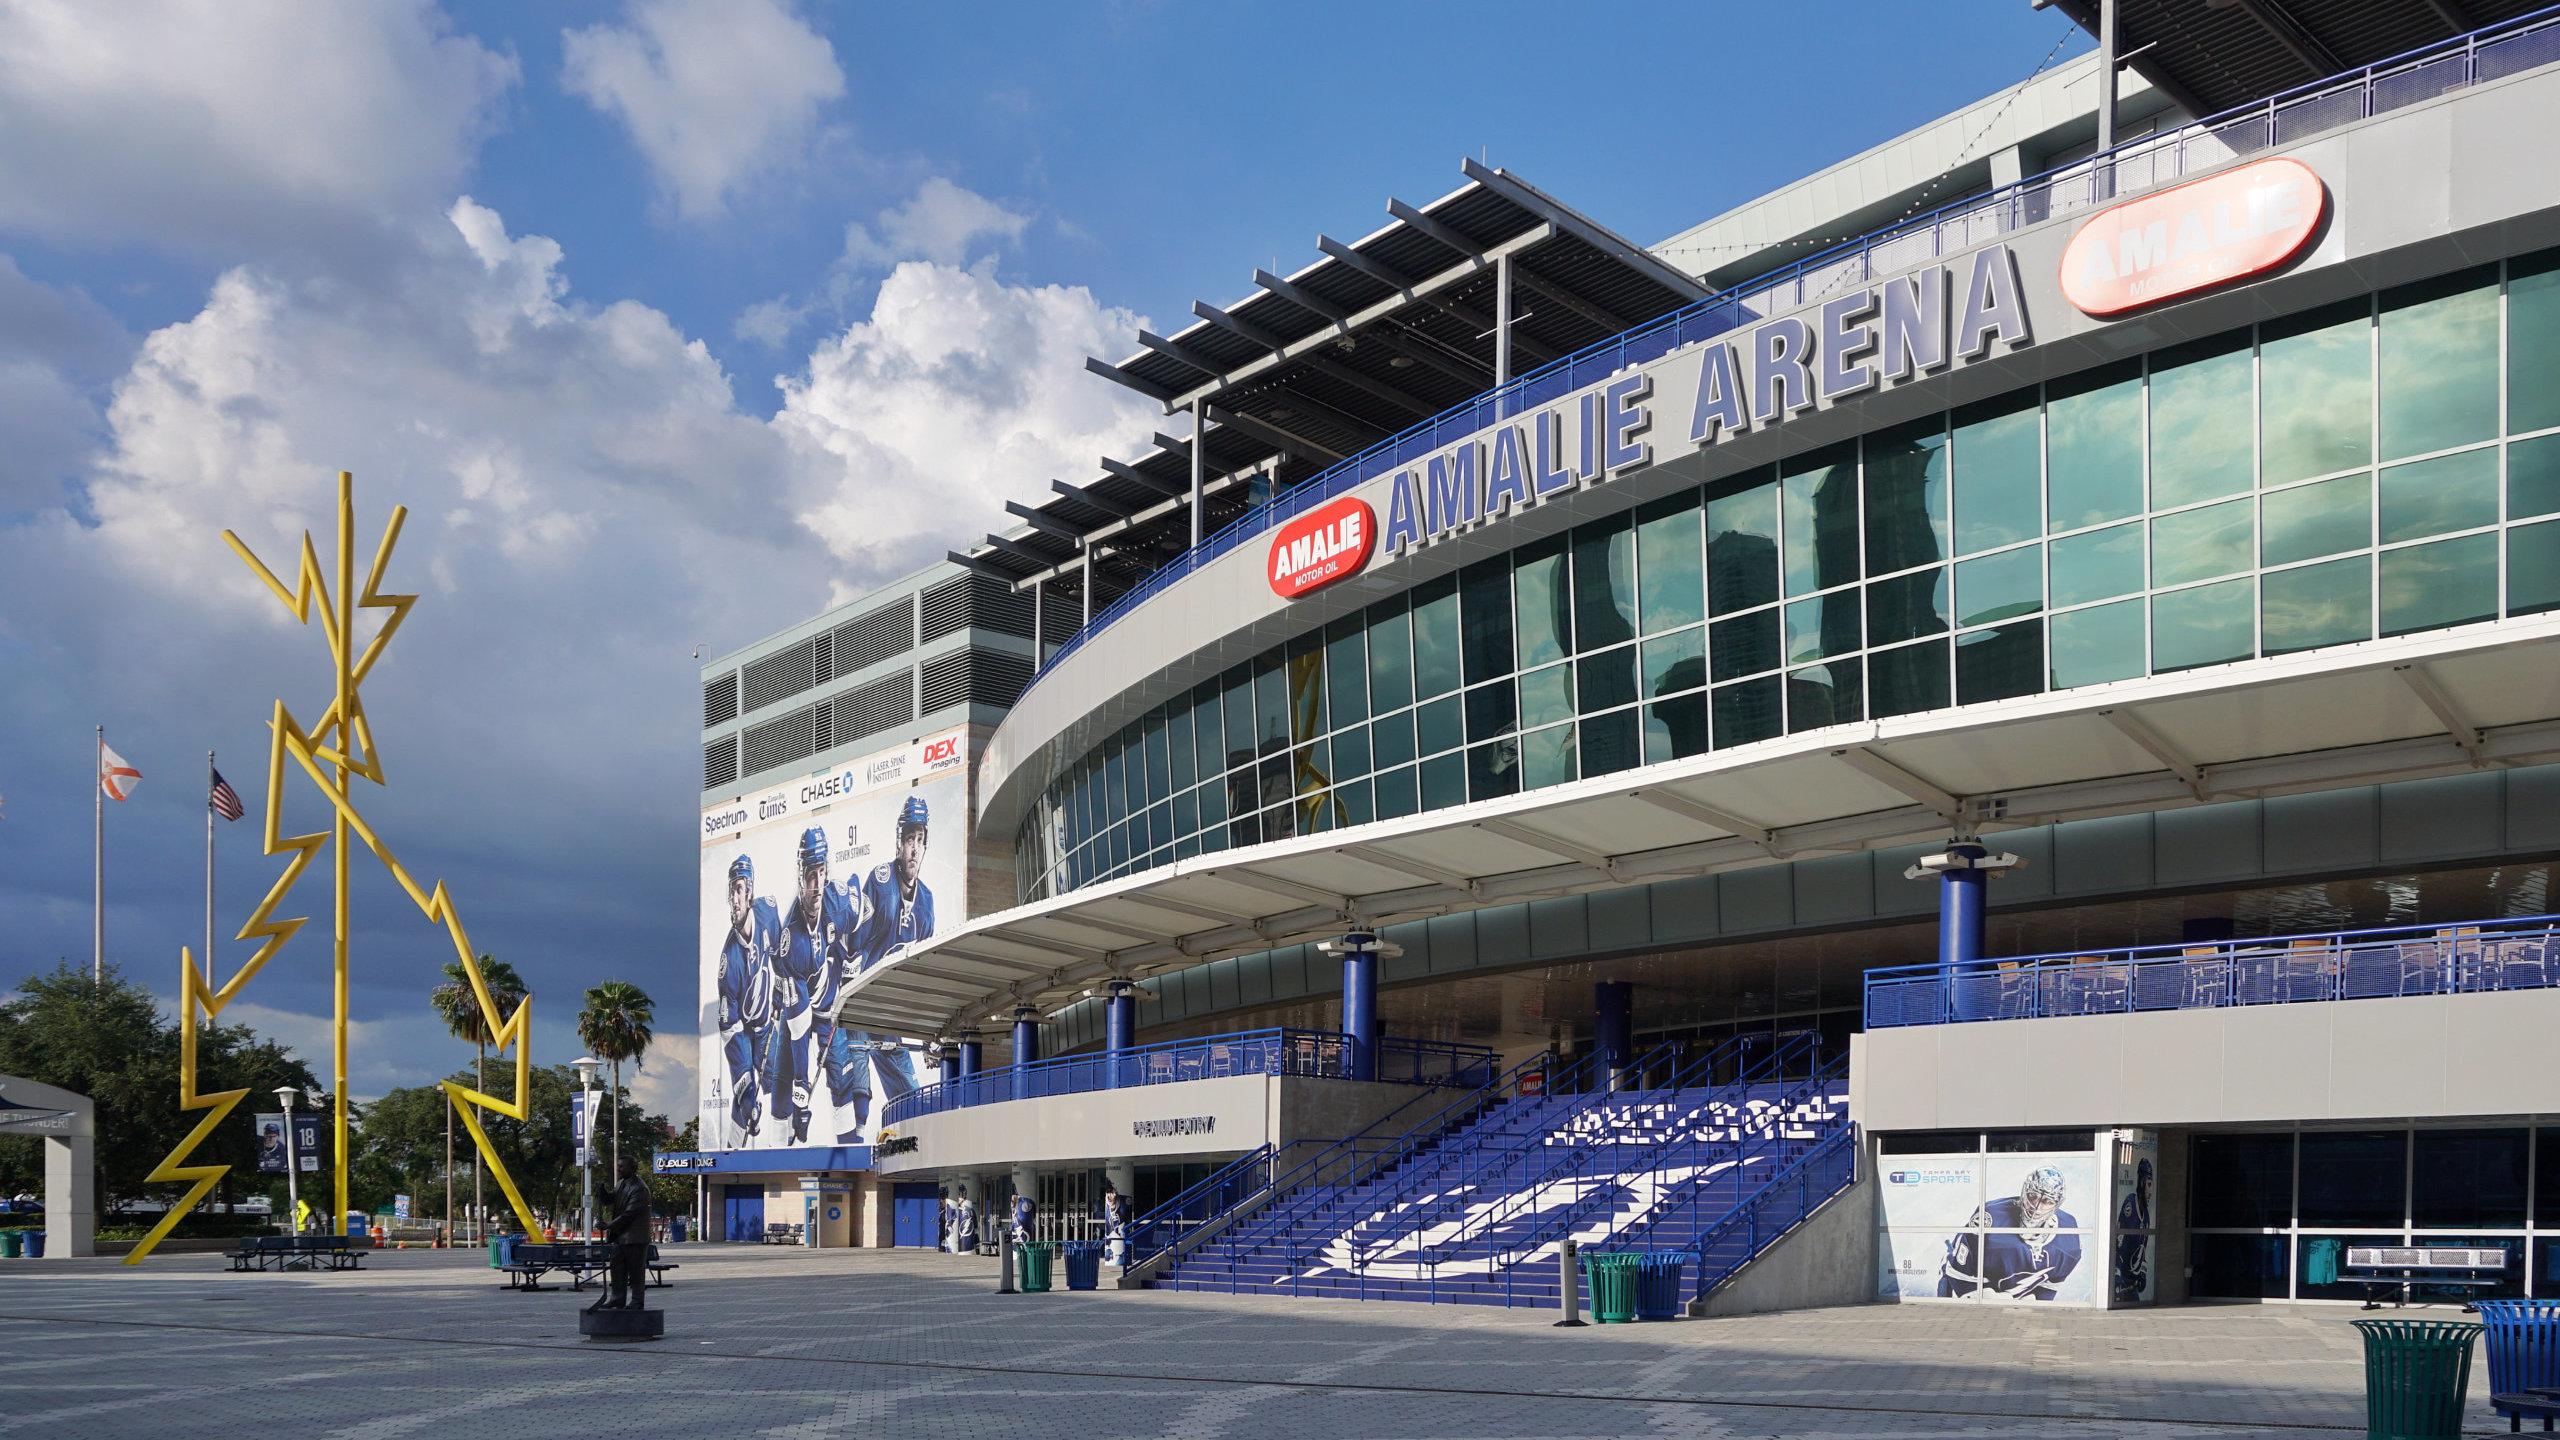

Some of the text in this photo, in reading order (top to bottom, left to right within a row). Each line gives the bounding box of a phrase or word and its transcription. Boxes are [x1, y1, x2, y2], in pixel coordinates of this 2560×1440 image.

[2078, 178, 2302, 289] AMALIE
[2129, 253, 2242, 297] MOTOR OIL
[1384, 242, 2028, 556] AMALIE ARENA
[1275, 511, 1361, 581] AMALIE
[1295, 561, 1338, 587] MOTOR OIL
[924, 737, 957, 763] DEX
[931, 756, 960, 769] imaging
[873, 768, 901, 783] INSTITUTE
[801, 777, 840, 804] CHASE
[759, 800, 787, 820] Times
[705, 810, 746, 835] Spectrum
[848, 825, 857, 847] 91
[712, 1078, 721, 1097] 24
[1178, 1116, 1215, 1135] ENTRY
[299, 1128, 315, 1147] 18
[664, 1159, 689, 1168] LEXUS
[1923, 1175, 1971, 1184] SPORTS
[1903, 1260, 1912, 1269] 88
